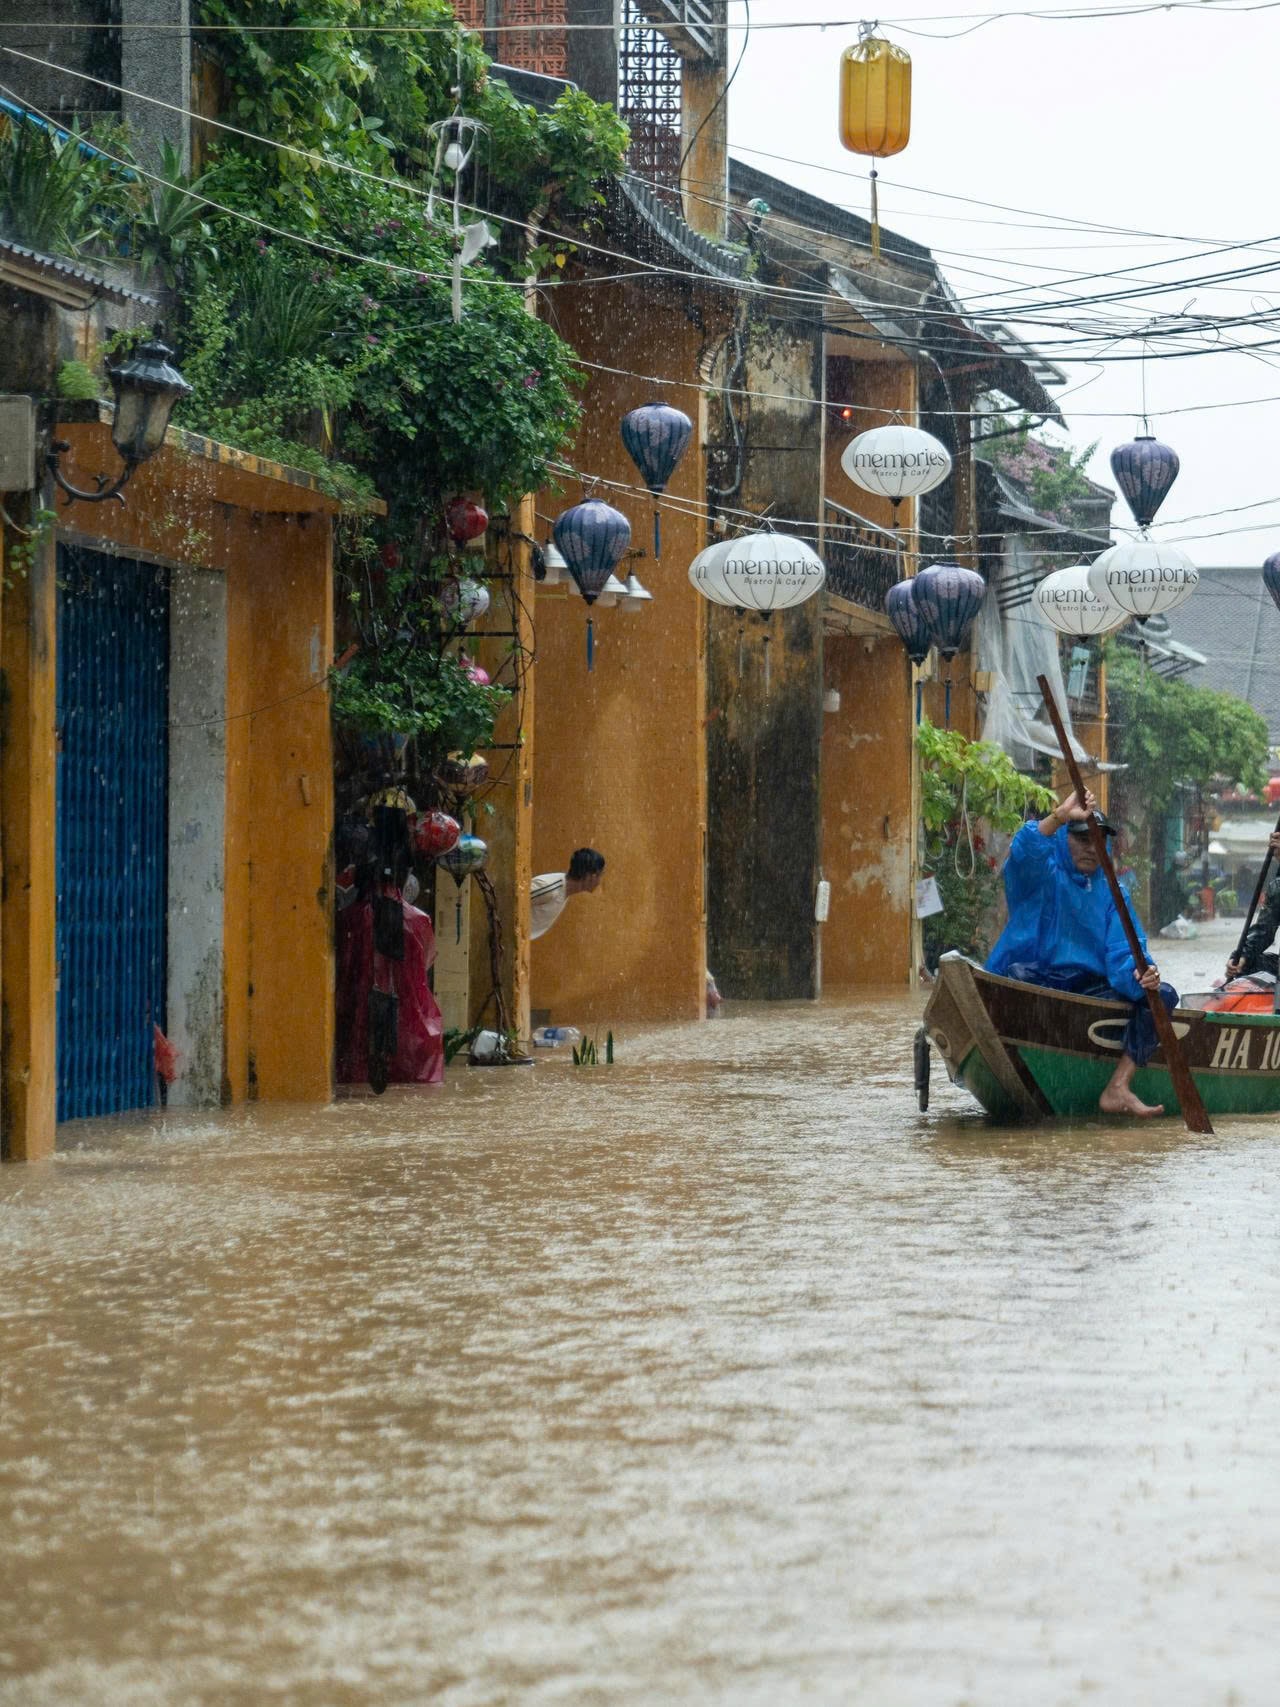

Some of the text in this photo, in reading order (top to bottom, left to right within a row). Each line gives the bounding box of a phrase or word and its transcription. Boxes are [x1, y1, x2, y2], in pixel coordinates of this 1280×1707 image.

[855, 448, 946, 468] memories
[725, 557, 821, 576] memories
[1209, 1027, 1252, 1070] HA
